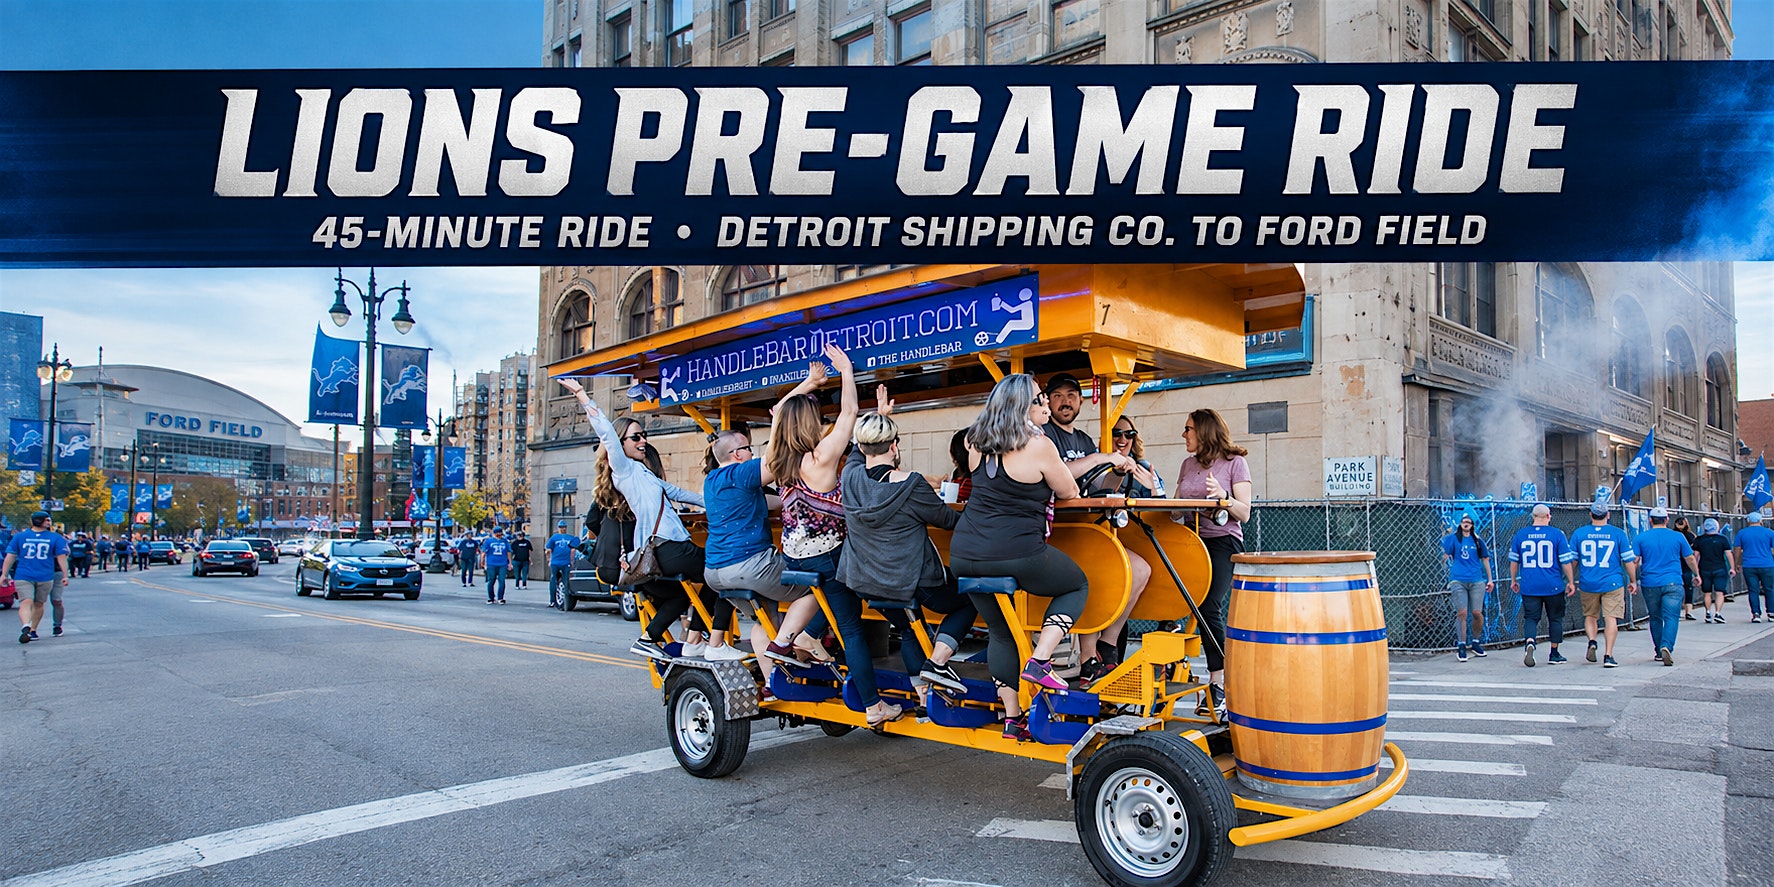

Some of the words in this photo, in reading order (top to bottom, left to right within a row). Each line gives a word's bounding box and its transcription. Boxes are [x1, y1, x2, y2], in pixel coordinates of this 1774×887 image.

[877, 352, 898, 366] THE
[900, 341, 963, 362] HANDLEBAR
[145, 411, 202, 431] FORD
[209, 419, 263, 438] FIELD
[1326, 472, 1373, 483] AVENUE
[1334, 462, 1365, 472] PARK
[1521, 540, 1554, 568] 20
[1581, 540, 1615, 567] 97
